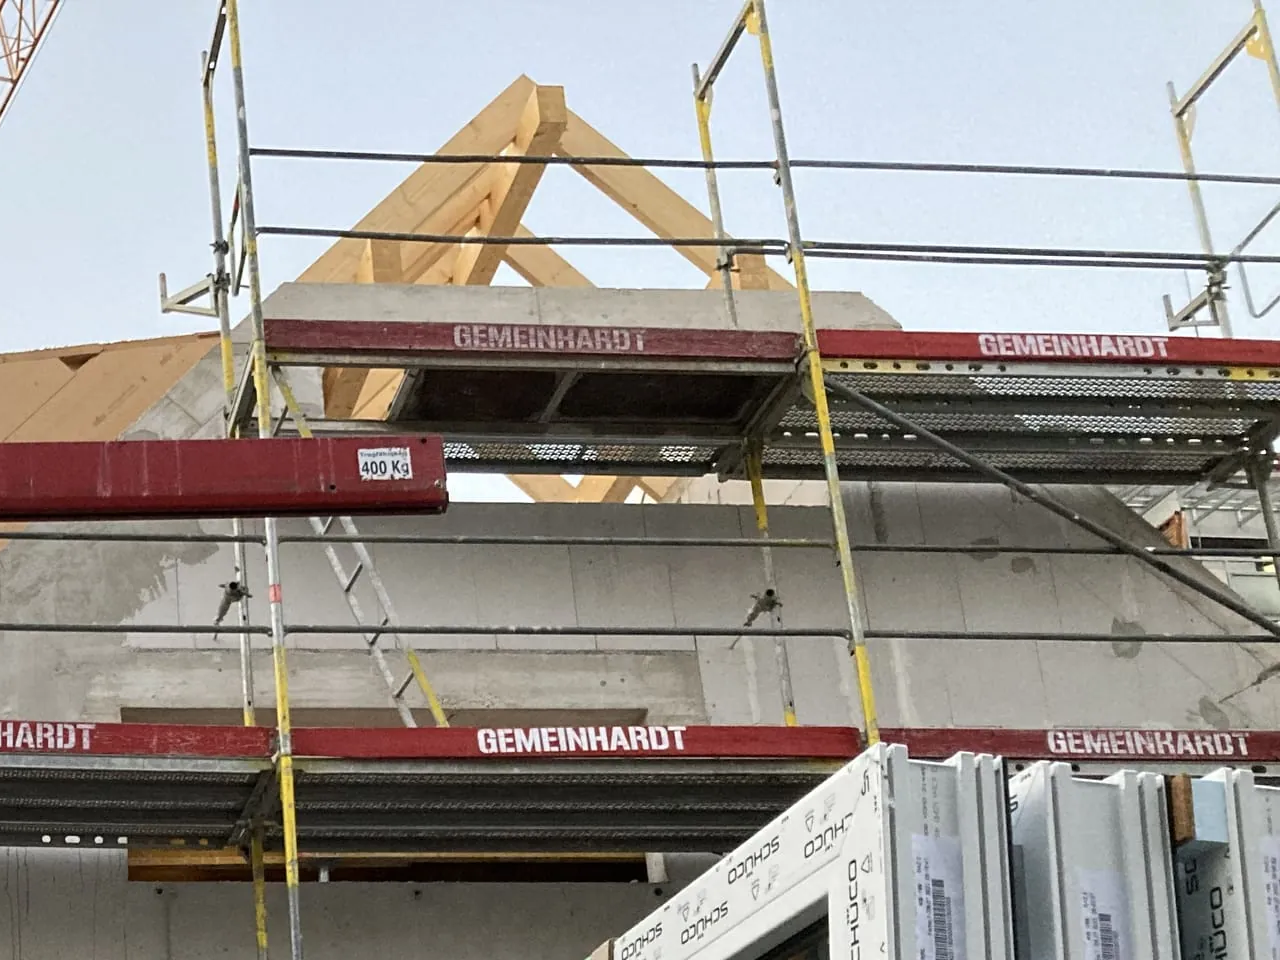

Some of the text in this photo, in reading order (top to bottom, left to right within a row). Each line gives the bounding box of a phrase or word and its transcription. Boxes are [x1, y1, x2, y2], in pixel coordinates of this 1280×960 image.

[453, 324, 646, 353] GEMEINHARDT
[978, 332, 1170, 359] GEMEINHARDT
[361, 460, 410, 478] 400 Kg
[476, 725, 687, 756] GEMEINHARDT
[728, 836, 780, 885] SCHÜCO
[681, 901, 729, 945] SCHÜCO
